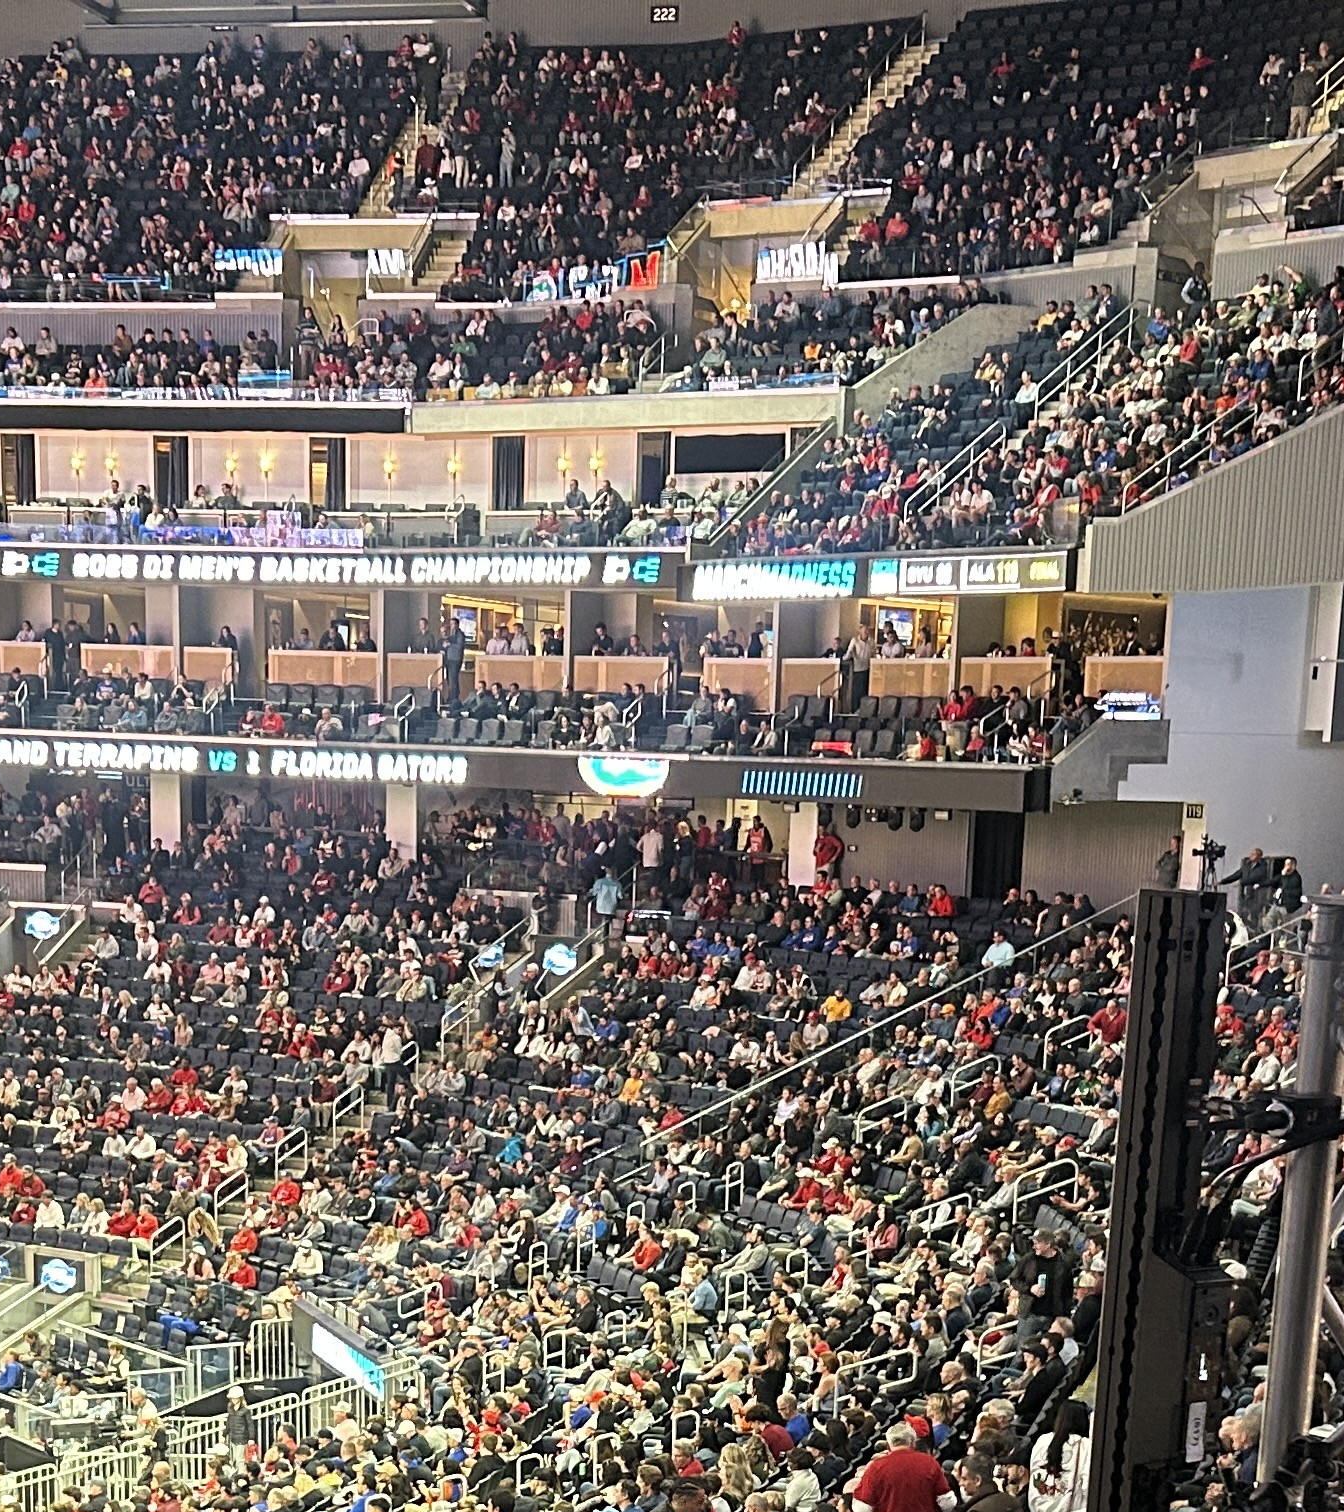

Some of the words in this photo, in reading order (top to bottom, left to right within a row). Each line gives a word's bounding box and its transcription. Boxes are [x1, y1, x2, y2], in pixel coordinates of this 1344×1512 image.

[653, 7, 676, 21] 222
[178, 555, 255, 581] MEN'S
[259, 556, 406, 584] BASKETBALL
[411, 555, 591, 584] CHAMPIONSHIP
[53, 740, 199, 773] TERRAPINS
[208, 749, 237, 772] VS
[271, 750, 374, 781] FLORIDA
[377, 754, 468, 784] GATORS
